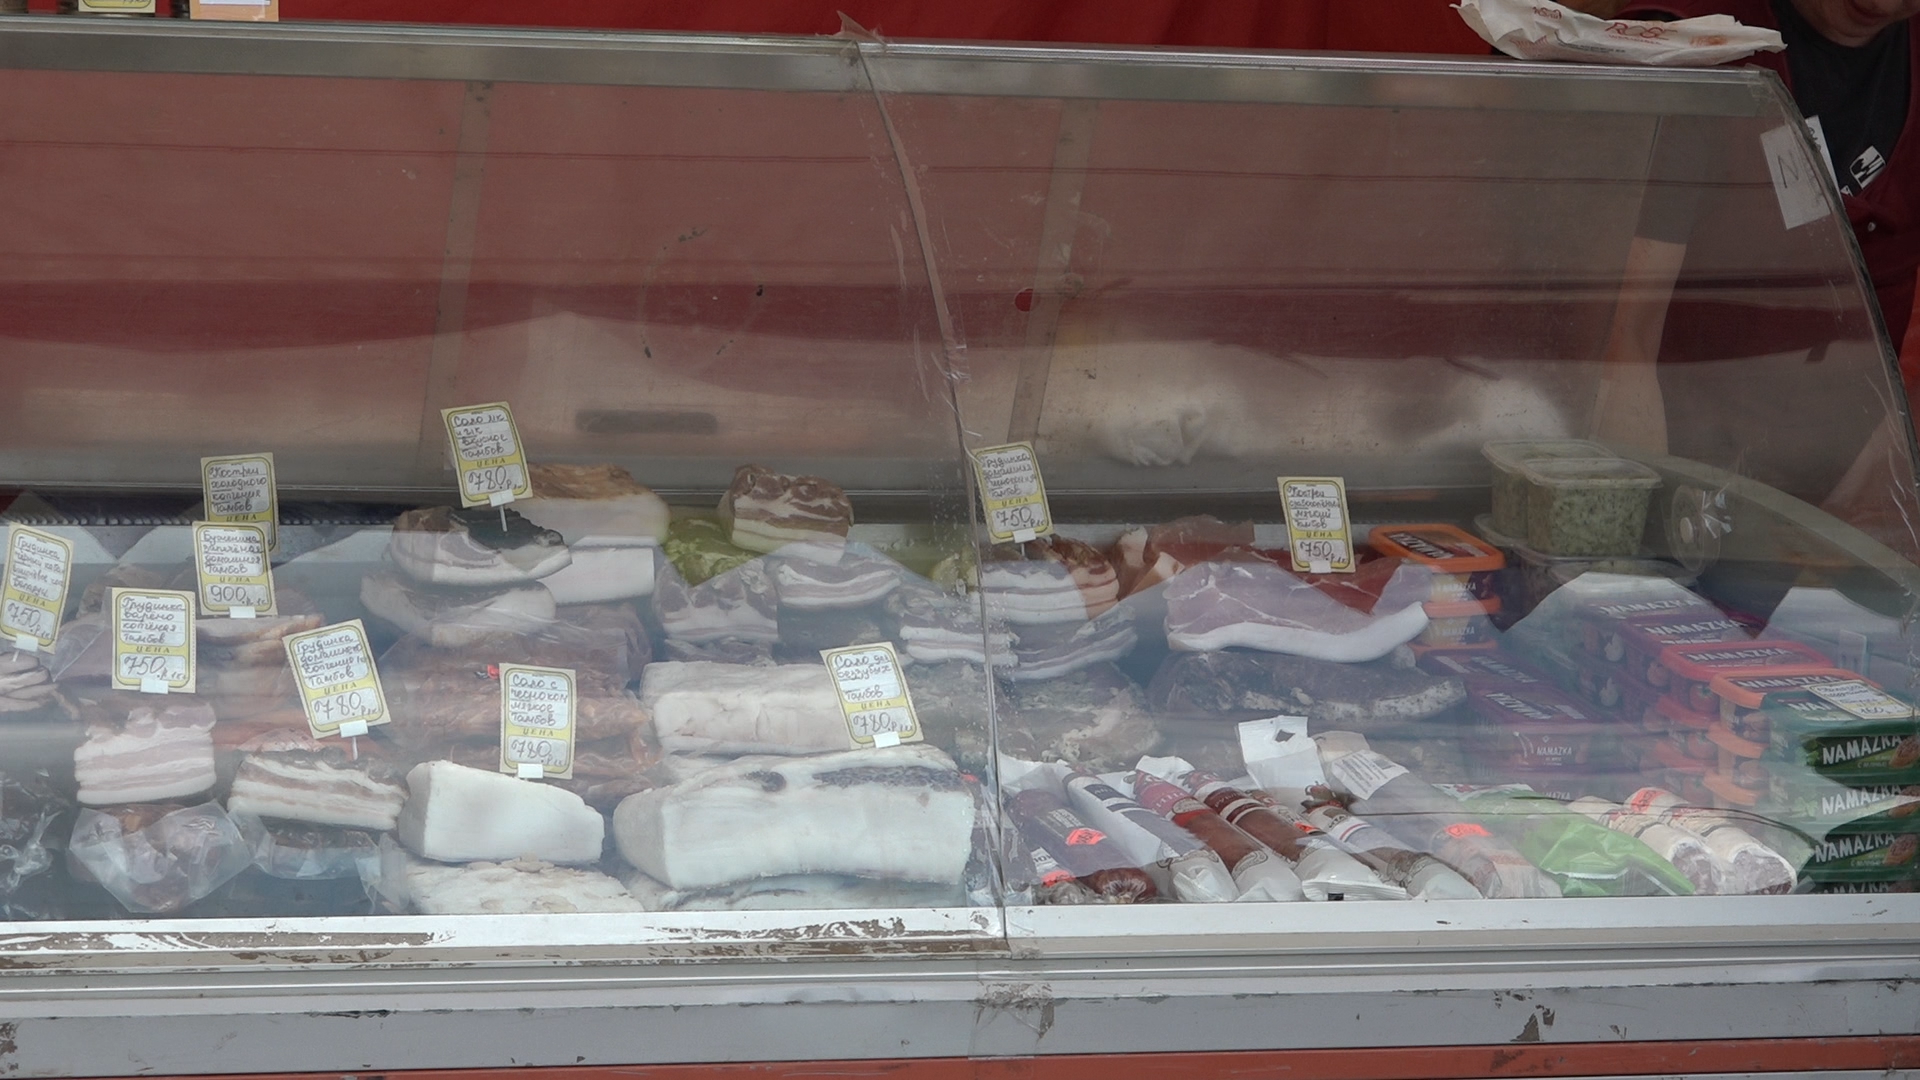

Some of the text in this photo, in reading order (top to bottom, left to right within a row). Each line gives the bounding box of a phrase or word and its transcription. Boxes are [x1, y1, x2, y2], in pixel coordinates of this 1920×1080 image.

[476, 458, 506, 467] ЦЕНА
[212, 498, 253, 513] Тамбов
[1002, 498, 1029, 508] ЦЕНА
[226, 513, 257, 522] ЦЕНА
[206, 563, 248, 575] Тамбов
[19, 594, 46, 607] ЦЕНА
[122, 597, 186, 613] Грудинка
[1644, 619, 1748, 635] NAMAZKA
[124, 632, 166, 644] Тамбов
[296, 635, 354, 655] Грудинка
[1686, 648, 1793, 661] NAMAZKA
[306, 666, 354, 686] Тамбов
[512, 674, 558, 689] Сало с
[1736, 675, 1843, 689] NAMAZKA
[324, 682, 357, 695] ЦЕНА
[845, 684, 883, 700] Тамбов
[861, 700, 891, 710] ЦЕНА
[511, 712, 556, 726] Тамбов
[523, 728, 554, 737] ЦЕНА
[1536, 746, 1573, 756] NAMAZKA
[1822, 735, 1902, 765] NAMAZKA
[1815, 834, 1895, 863] NAMAZKA
